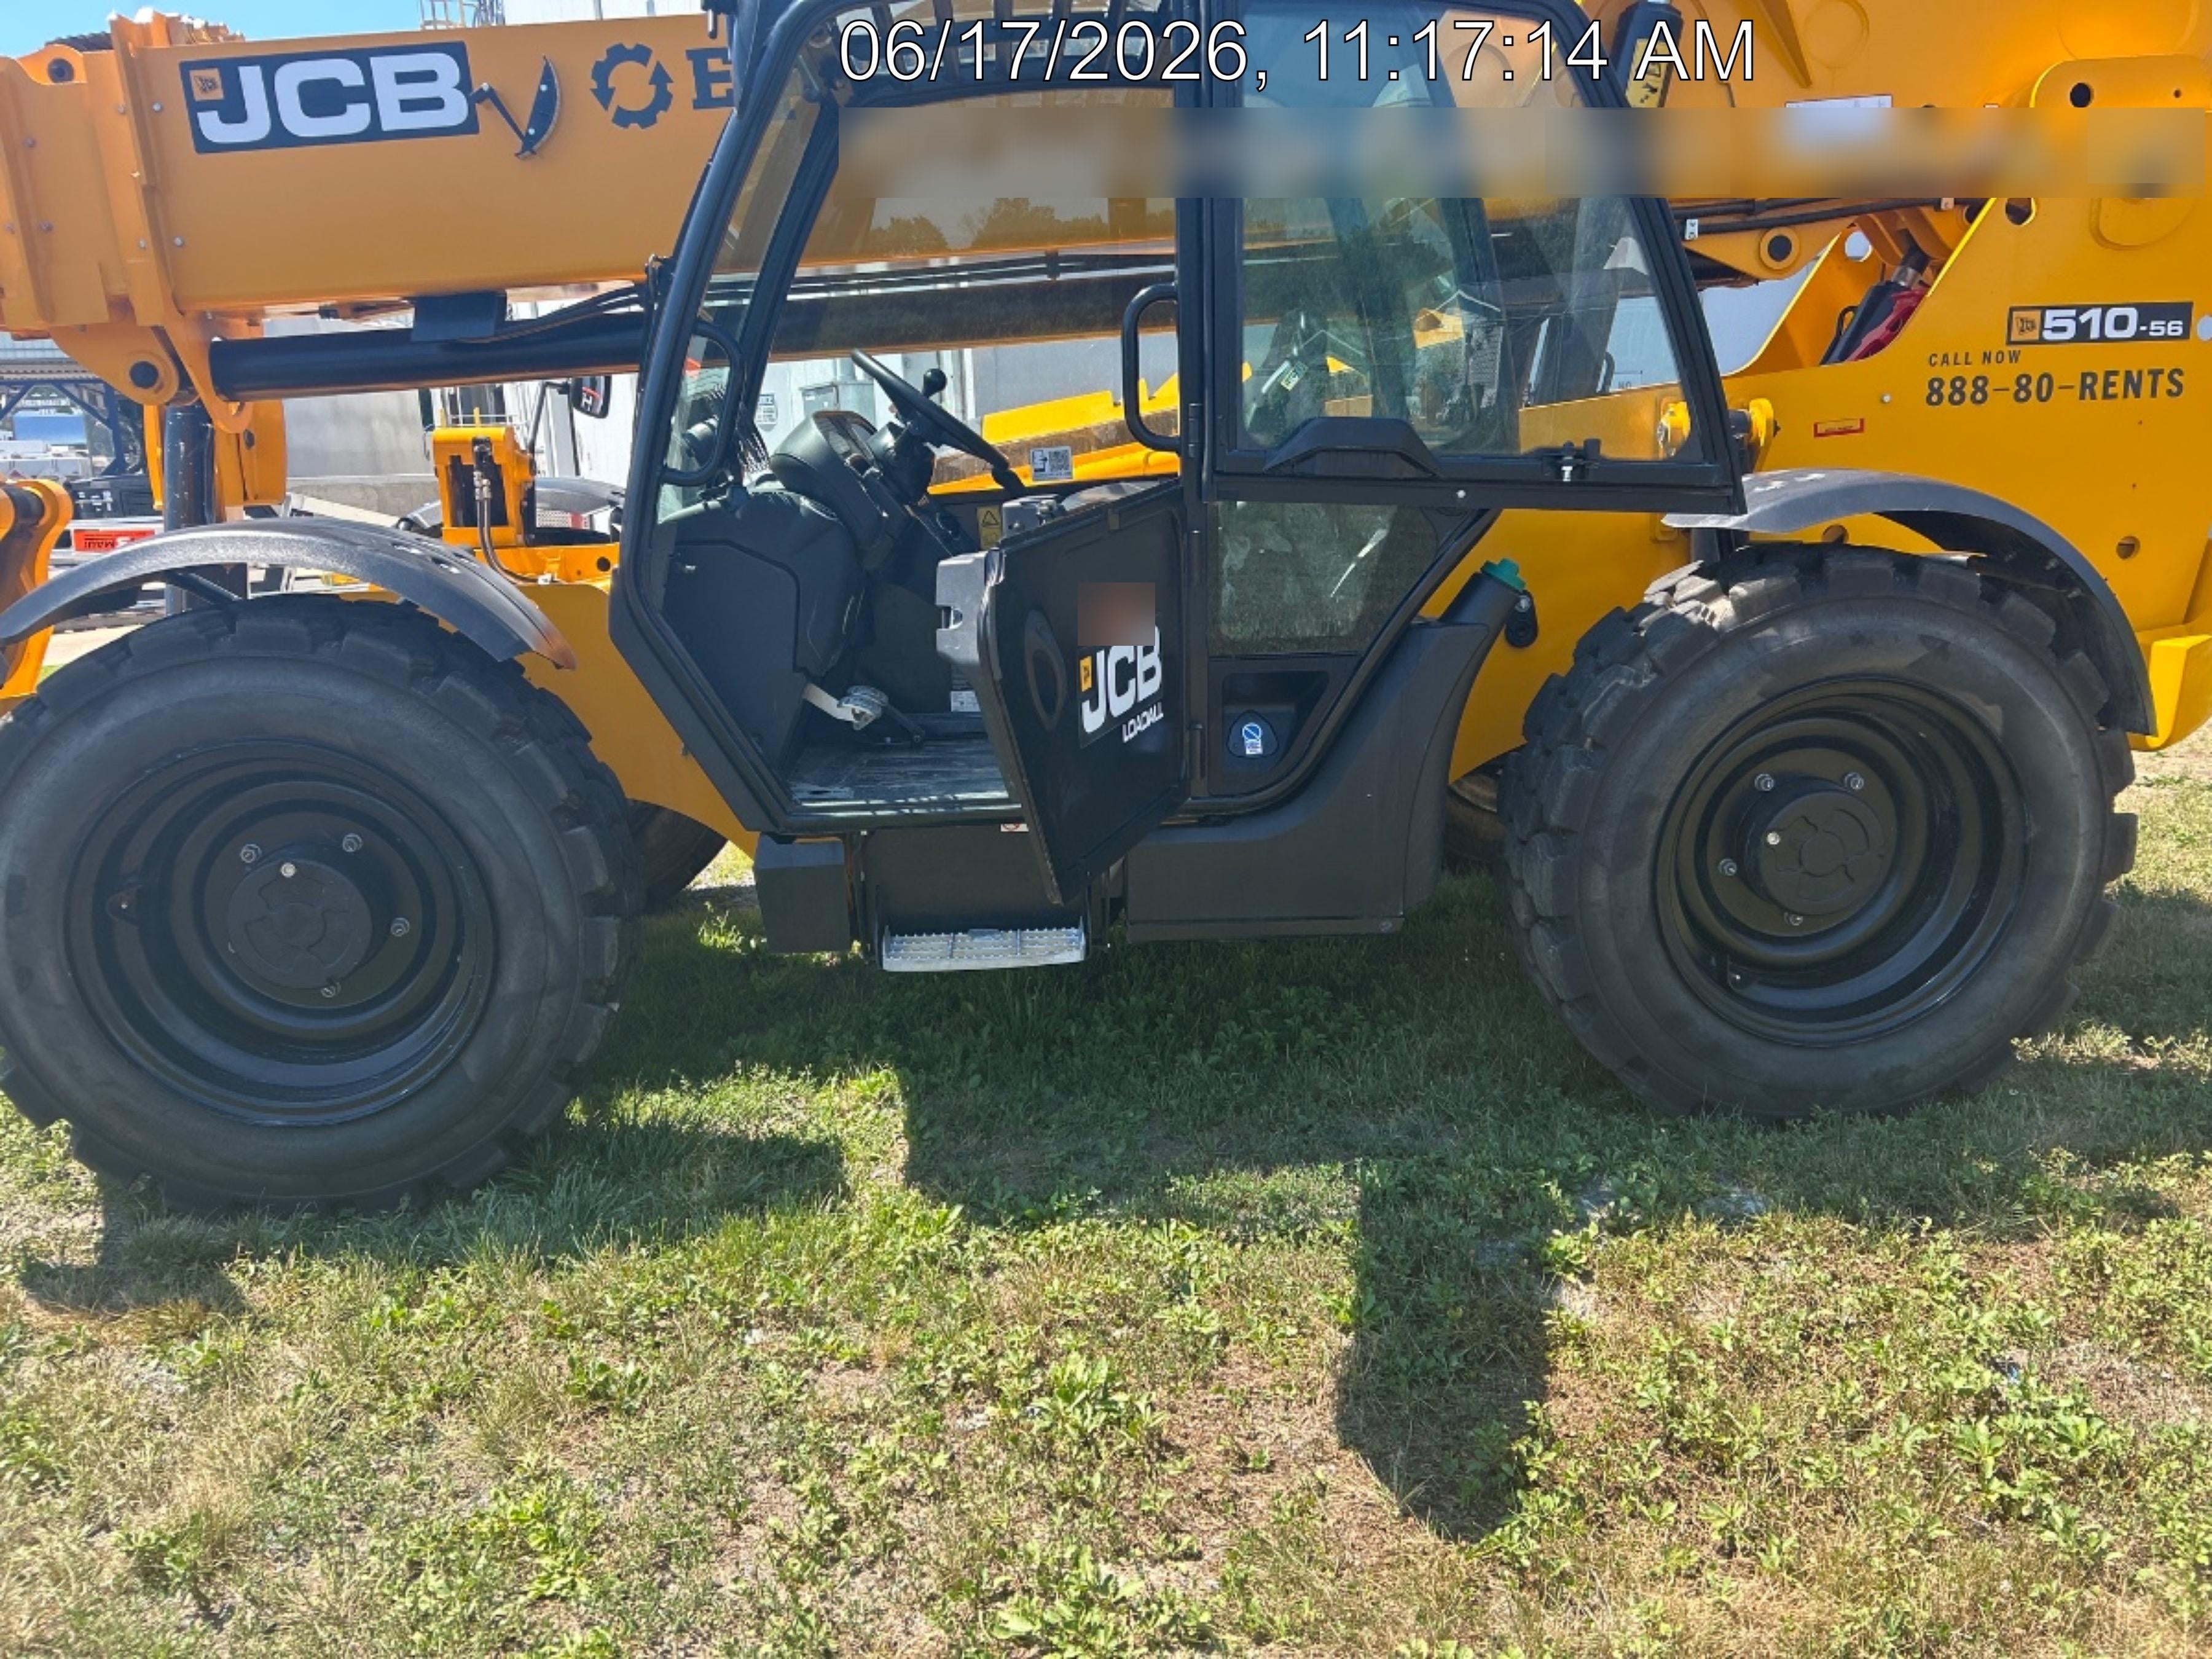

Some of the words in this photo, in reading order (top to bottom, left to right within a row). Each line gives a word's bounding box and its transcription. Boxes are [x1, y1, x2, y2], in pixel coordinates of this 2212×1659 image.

[196, 52, 469, 144] JCB
[2042, 307, 2184, 340] 510-56
[1929, 351, 1973, 367] CALL
[1982, 349, 2022, 365] NOW
[1925, 368, 2185, 406] 888-80-RENTS
[1081, 625, 1162, 734] JCB
[1121, 702, 1164, 743] LOADALL
